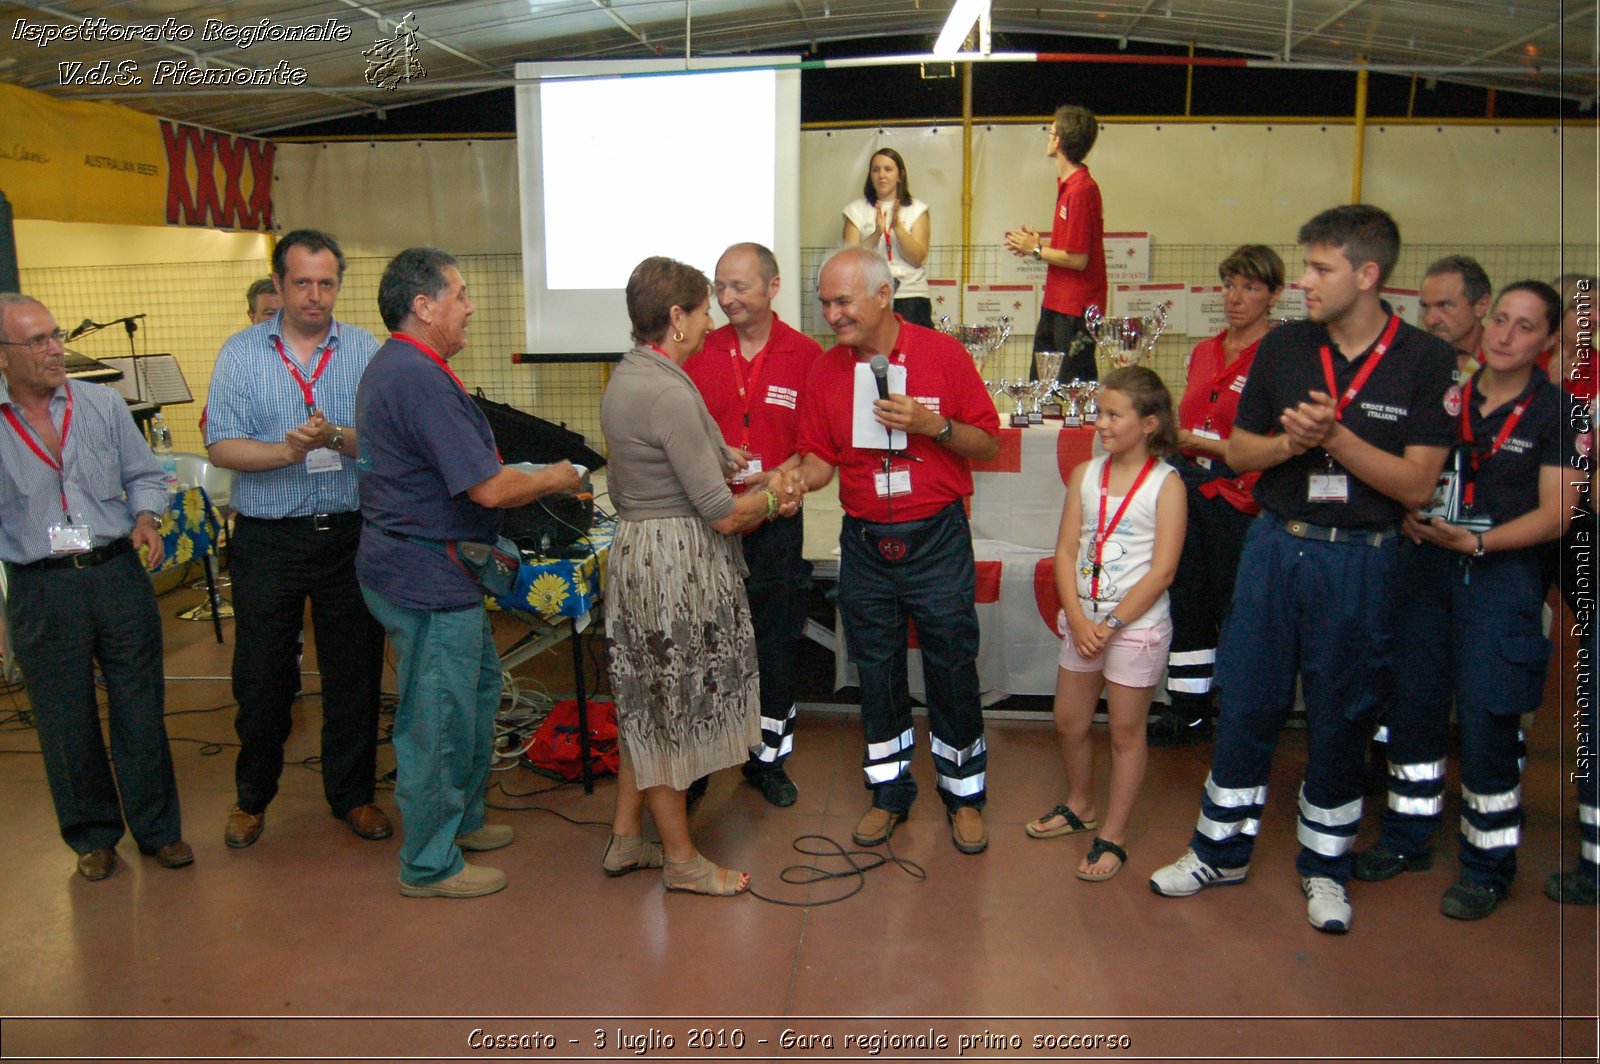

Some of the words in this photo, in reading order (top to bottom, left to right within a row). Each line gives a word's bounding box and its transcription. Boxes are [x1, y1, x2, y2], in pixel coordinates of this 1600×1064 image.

[84, 154, 135, 174] AUSTRALIAN
[137, 163, 159, 177] BEER
[160, 118, 276, 231] XXXX
[1361, 402, 1384, 412] CROCE
[1385, 405, 1408, 416] ROSSA
[1367, 410, 1398, 421] ITALIANA
